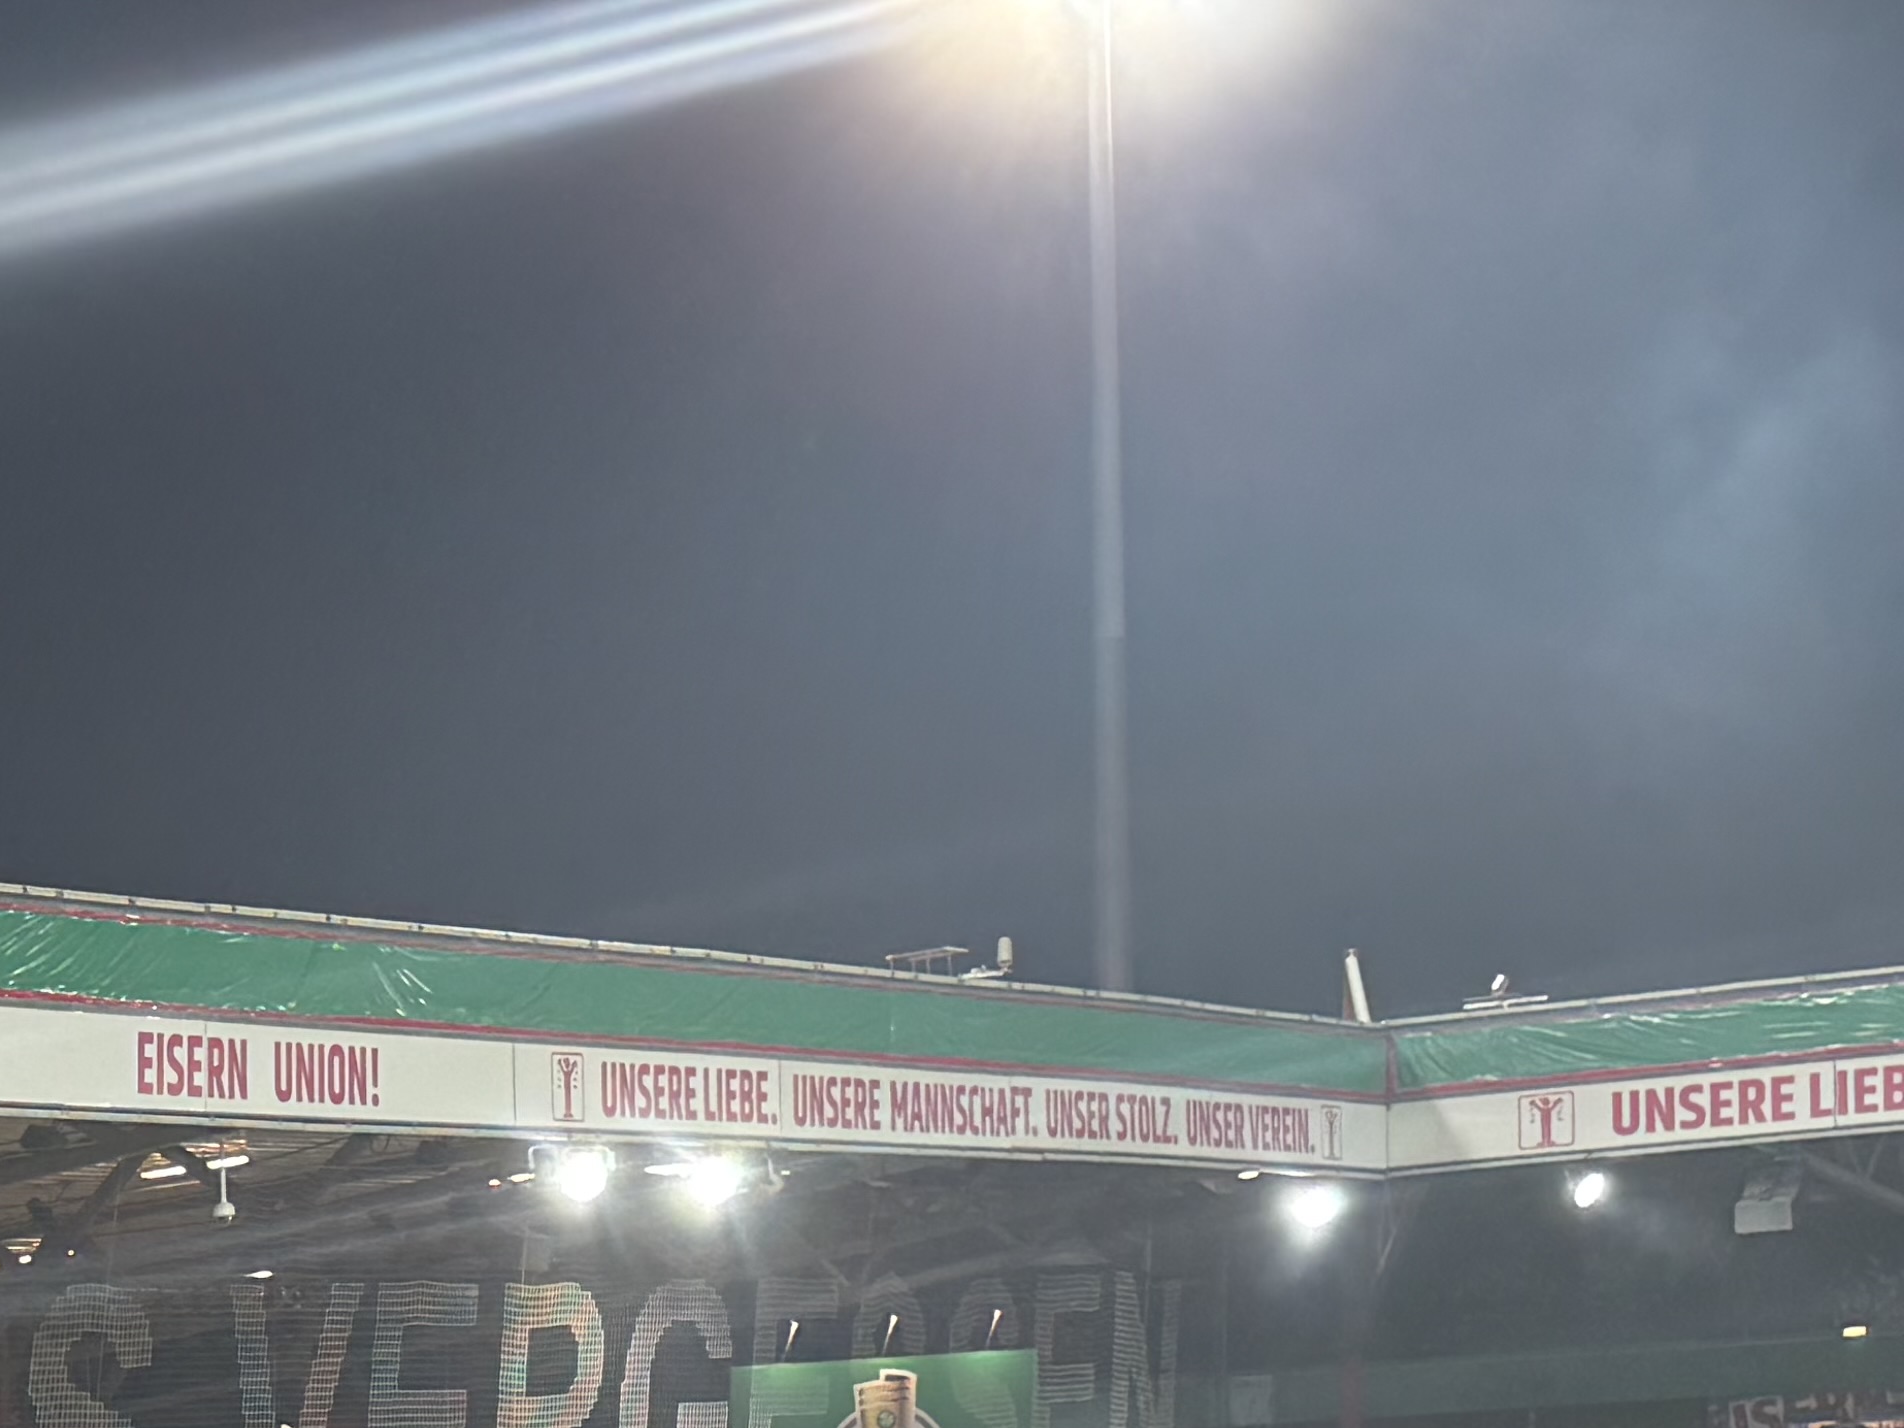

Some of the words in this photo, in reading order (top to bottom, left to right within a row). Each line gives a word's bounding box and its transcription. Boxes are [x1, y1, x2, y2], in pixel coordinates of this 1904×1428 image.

[137, 1030, 248, 1101] EISERN
[274, 1041, 380, 1107] UNION!
[1612, 1075, 1795, 1136] UNSERE
[601, 1061, 697, 1122] UNSERE
[703, 1069, 777, 1126] LIEBE.
[793, 1073, 880, 1132] UNSERE
[890, 1080, 1038, 1139] MANNSCHAFT.
[1045, 1089, 1110, 1141] UNSER
[1115, 1094, 1178, 1146] STOLZ.
[1186, 1099, 1244, 1150] UNSER
[1248, 1104, 1315, 1156] VEREIN.
